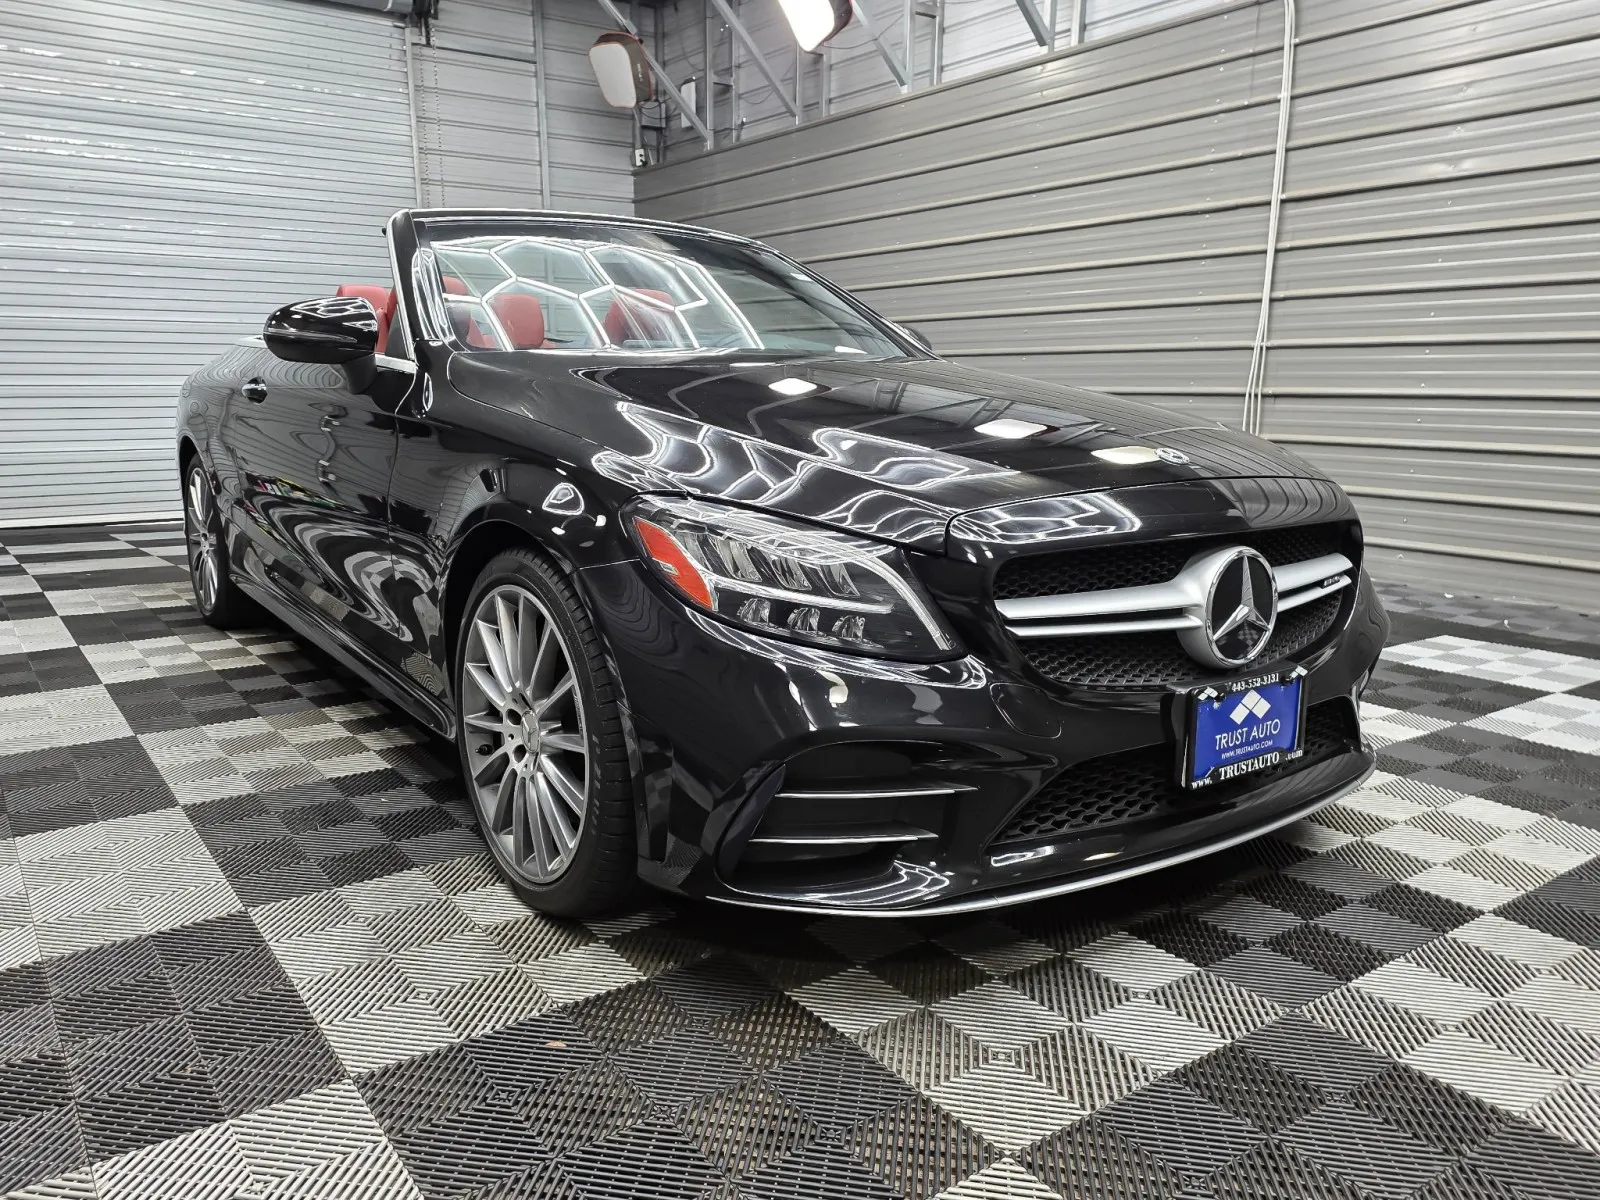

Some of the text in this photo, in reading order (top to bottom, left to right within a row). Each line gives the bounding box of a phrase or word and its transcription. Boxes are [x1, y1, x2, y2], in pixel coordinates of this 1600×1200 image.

[1215, 718, 1281, 750] TRUST AUTO
[1219, 751, 1280, 780] TRUSTAUTO
